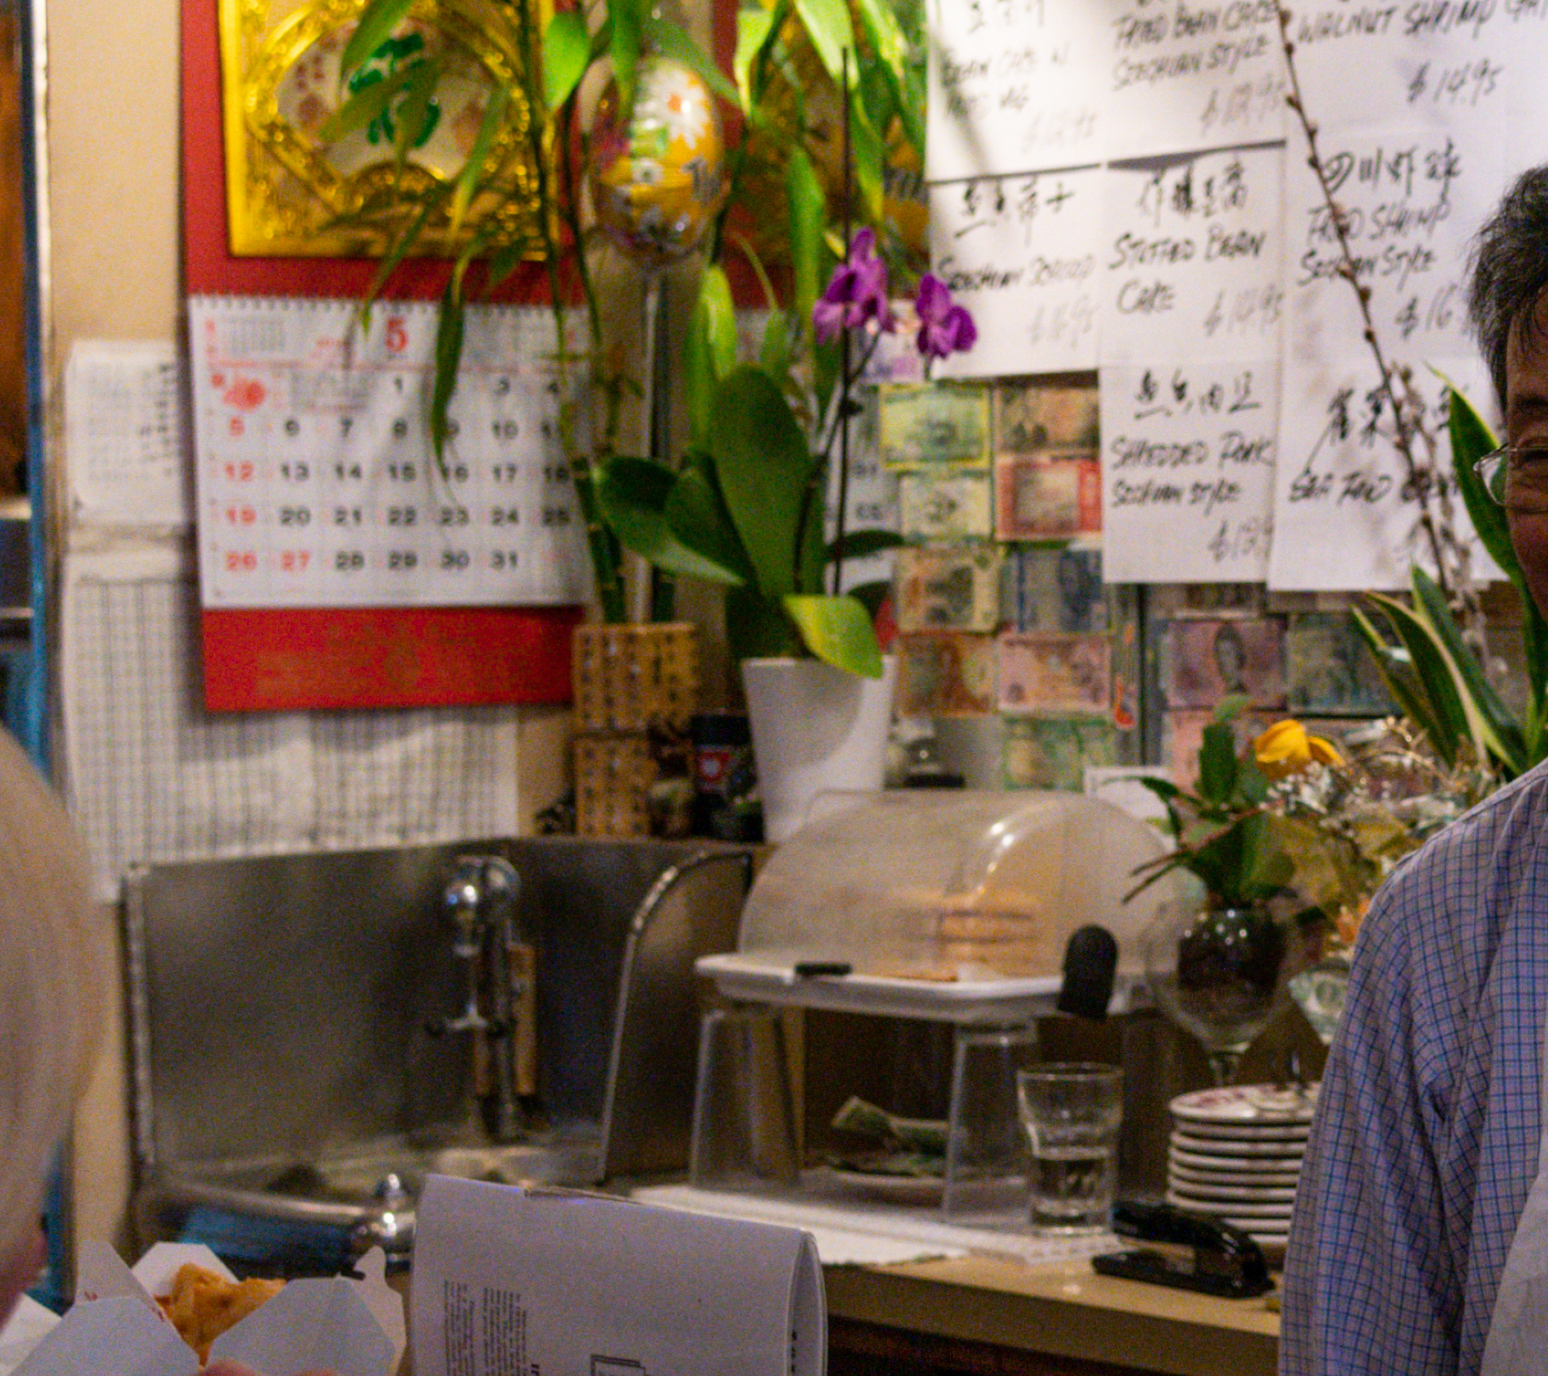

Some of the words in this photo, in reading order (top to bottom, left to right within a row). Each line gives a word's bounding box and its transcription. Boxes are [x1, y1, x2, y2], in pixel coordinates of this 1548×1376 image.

[1297, 2, 1398, 45] WALNUT
[1202, 222, 1269, 262] BEAN
[1116, 277, 1179, 316] CAKE
[384, 318, 409, 355] 5
[492, 419, 520, 440] 10
[280, 463, 311, 483] 13
[334, 463, 364, 482] 14
[491, 464, 519, 483] 17
[279, 507, 313, 526] 20
[333, 507, 364, 526] 21
[387, 507, 418, 526] 22
[440, 507, 471, 526] 23
[491, 507, 521, 526] 24
[281, 551, 313, 572] 27
[334, 551, 366, 572] 28
[387, 551, 419, 572] 29
[439, 551, 472, 572] 30
[491, 551, 520, 571] 31
